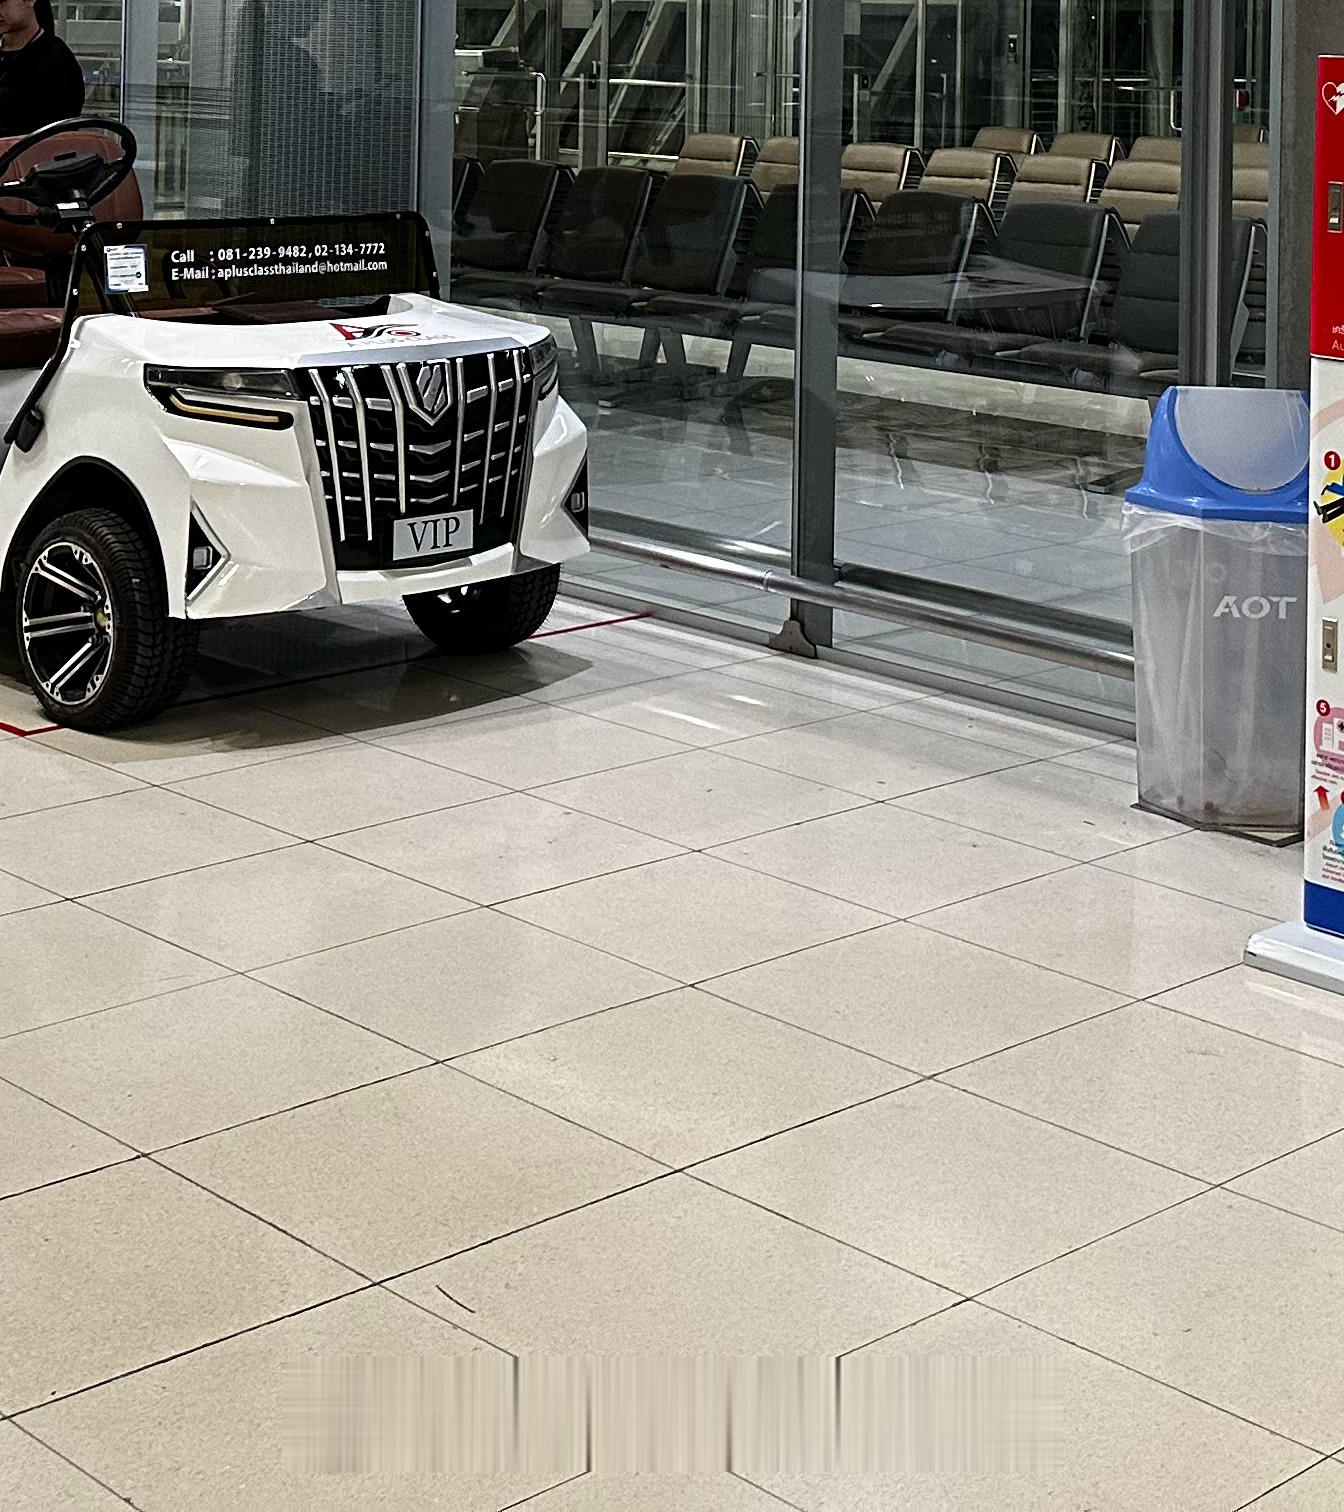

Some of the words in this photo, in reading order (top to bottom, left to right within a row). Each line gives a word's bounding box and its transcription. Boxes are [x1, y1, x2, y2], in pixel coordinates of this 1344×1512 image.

[171, 250, 195, 263] Call
[171, 266, 209, 281] E-Mail
[217, 259, 388, 281] aplusclassthailand@hotmail.com
[407, 514, 461, 554] VIP
[1213, 595, 1298, 619] AOT
